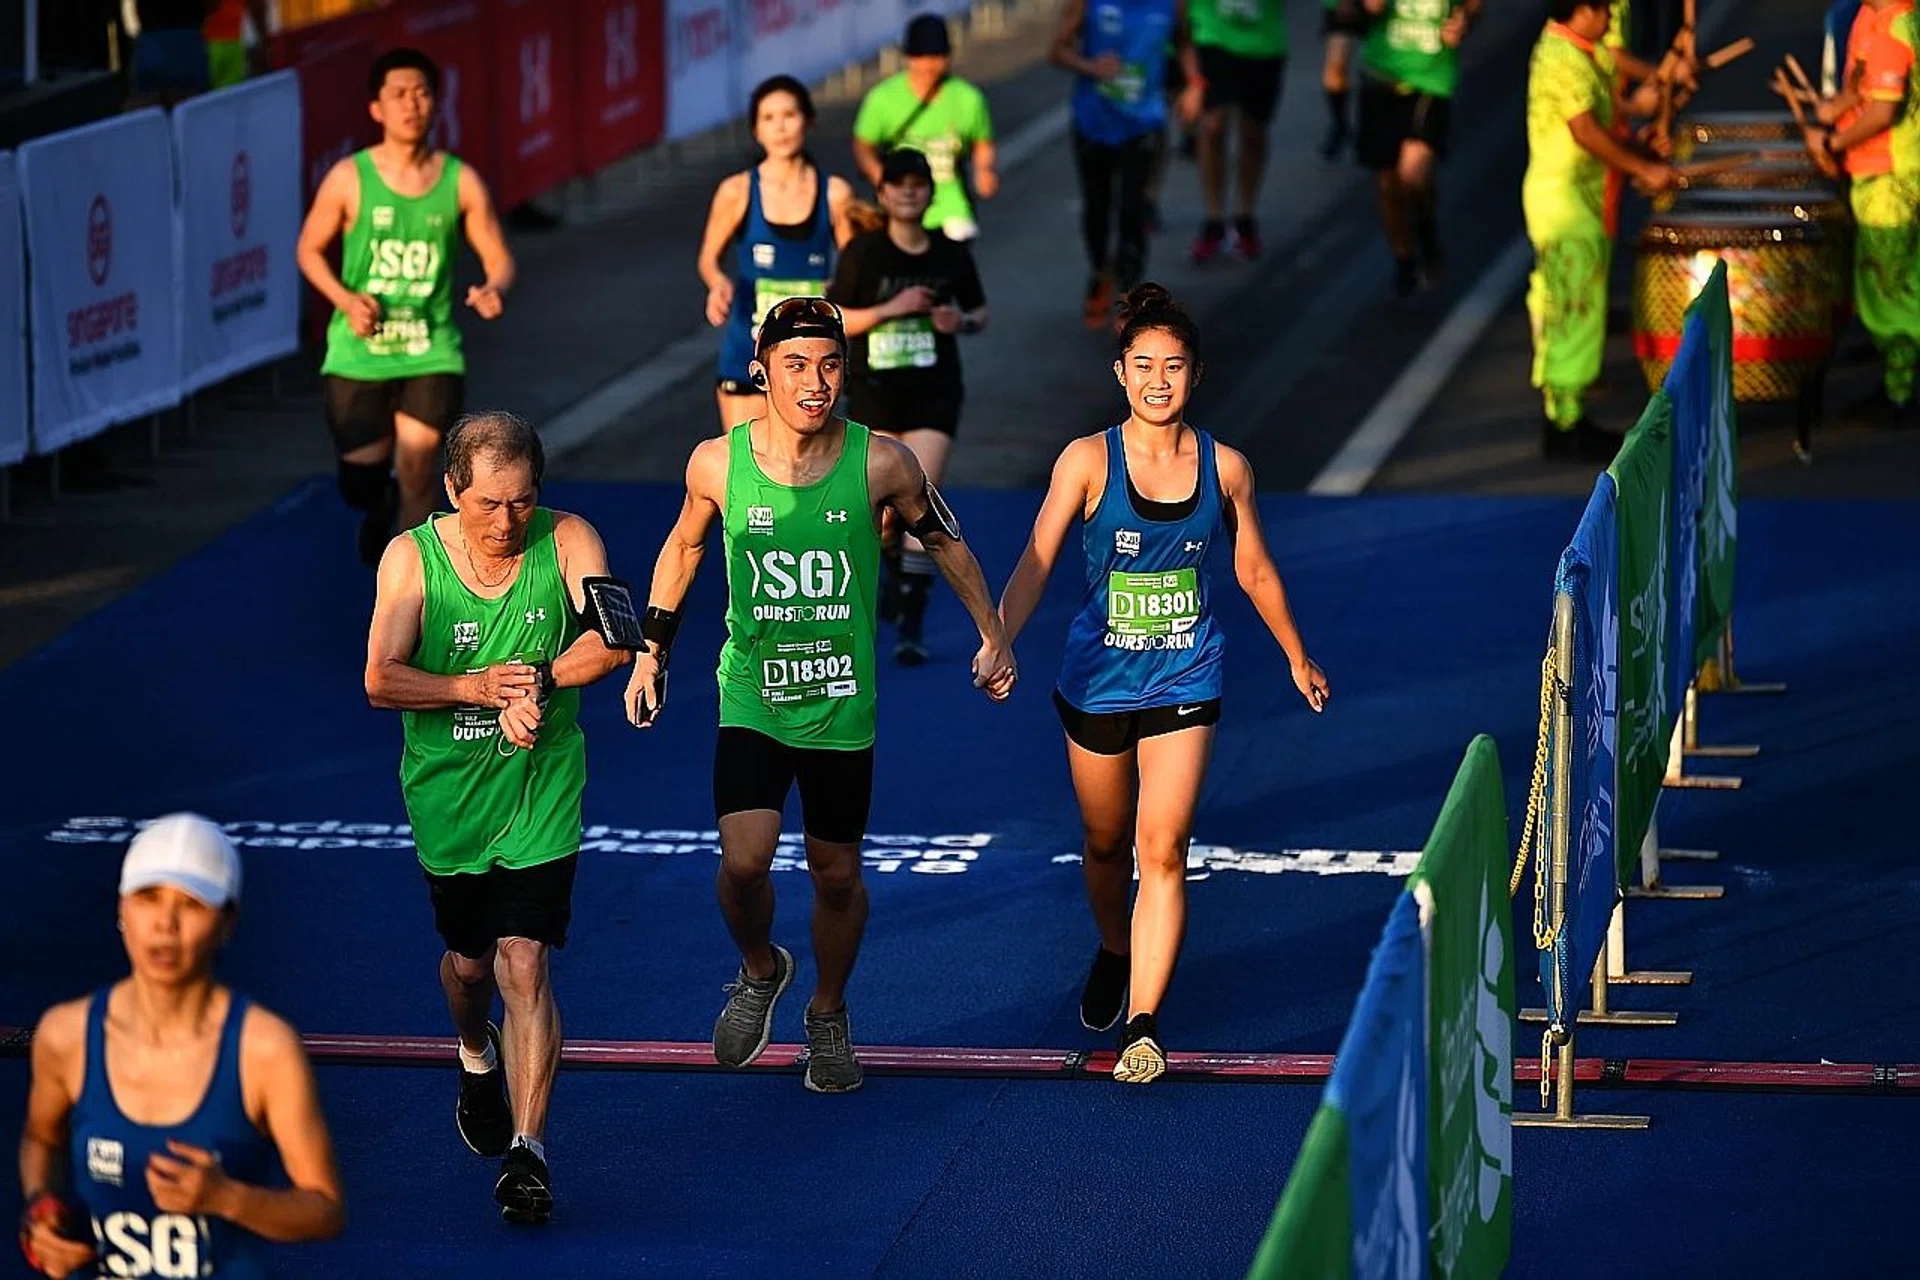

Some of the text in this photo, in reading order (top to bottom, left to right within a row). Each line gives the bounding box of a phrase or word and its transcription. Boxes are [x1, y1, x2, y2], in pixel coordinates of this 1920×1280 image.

[1115, 590, 1194, 617] D 18301
[768, 655, 853, 684] D 18302
